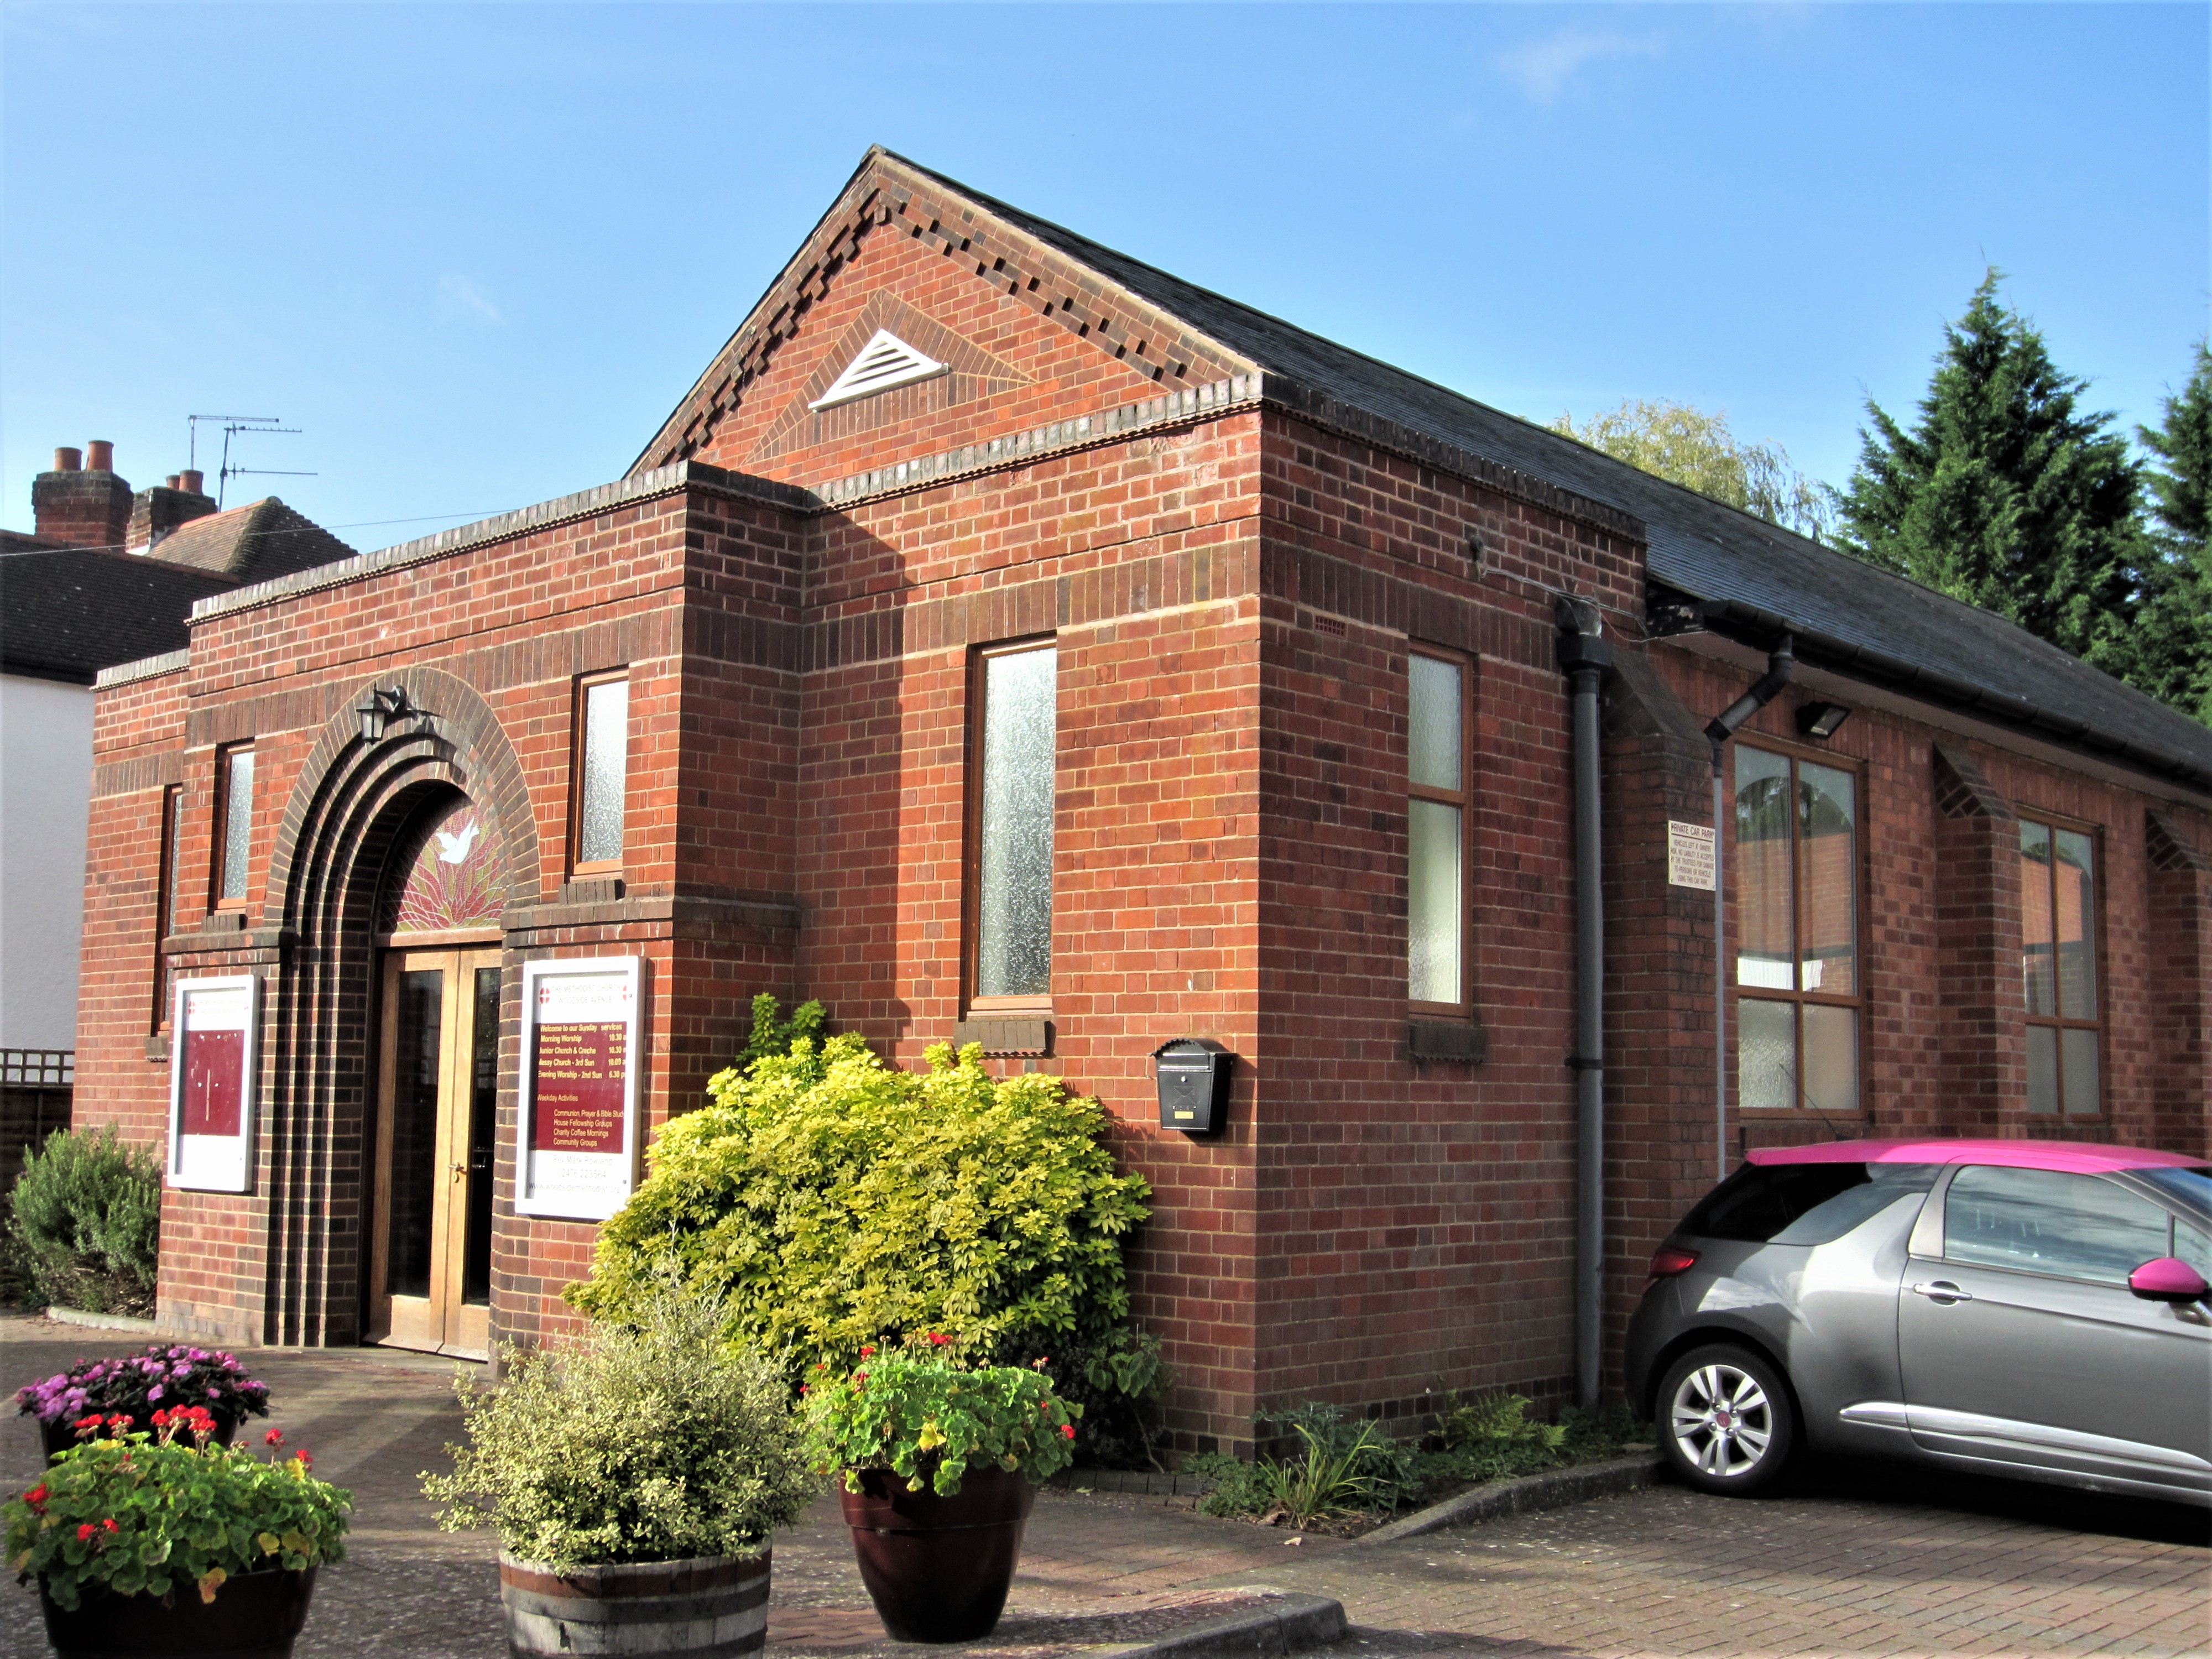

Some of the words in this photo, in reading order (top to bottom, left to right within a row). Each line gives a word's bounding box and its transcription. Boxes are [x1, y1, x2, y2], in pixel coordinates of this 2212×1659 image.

[1671, 823, 1689, 834] PRIVATE
[1691, 827, 1700, 836] CAR
[1702, 829, 1714, 838] PARK
[578, 1024, 597, 1032] Sunday
[540, 1035, 560, 1044] Morning
[561, 1035, 582, 1044] Worship
[557, 1070, 577, 1080] Worship
[592, 1071, 602, 1079] Sun
[609, 1070, 620, 1078] 6.30
[537, 1094, 557, 1103] Weekday
[581, 1109, 596, 1119] Prayer
[569, 1119, 594, 1128] Fellowship
[595, 1119, 612, 1128] Groups
[553, 1128, 570, 1137] Charity
[570, 1128, 586, 1136] Coffee
[587, 1129, 609, 1138] Mornings
[553, 1138, 579, 1147] Community
[580, 1139, 597, 1147] Groups
